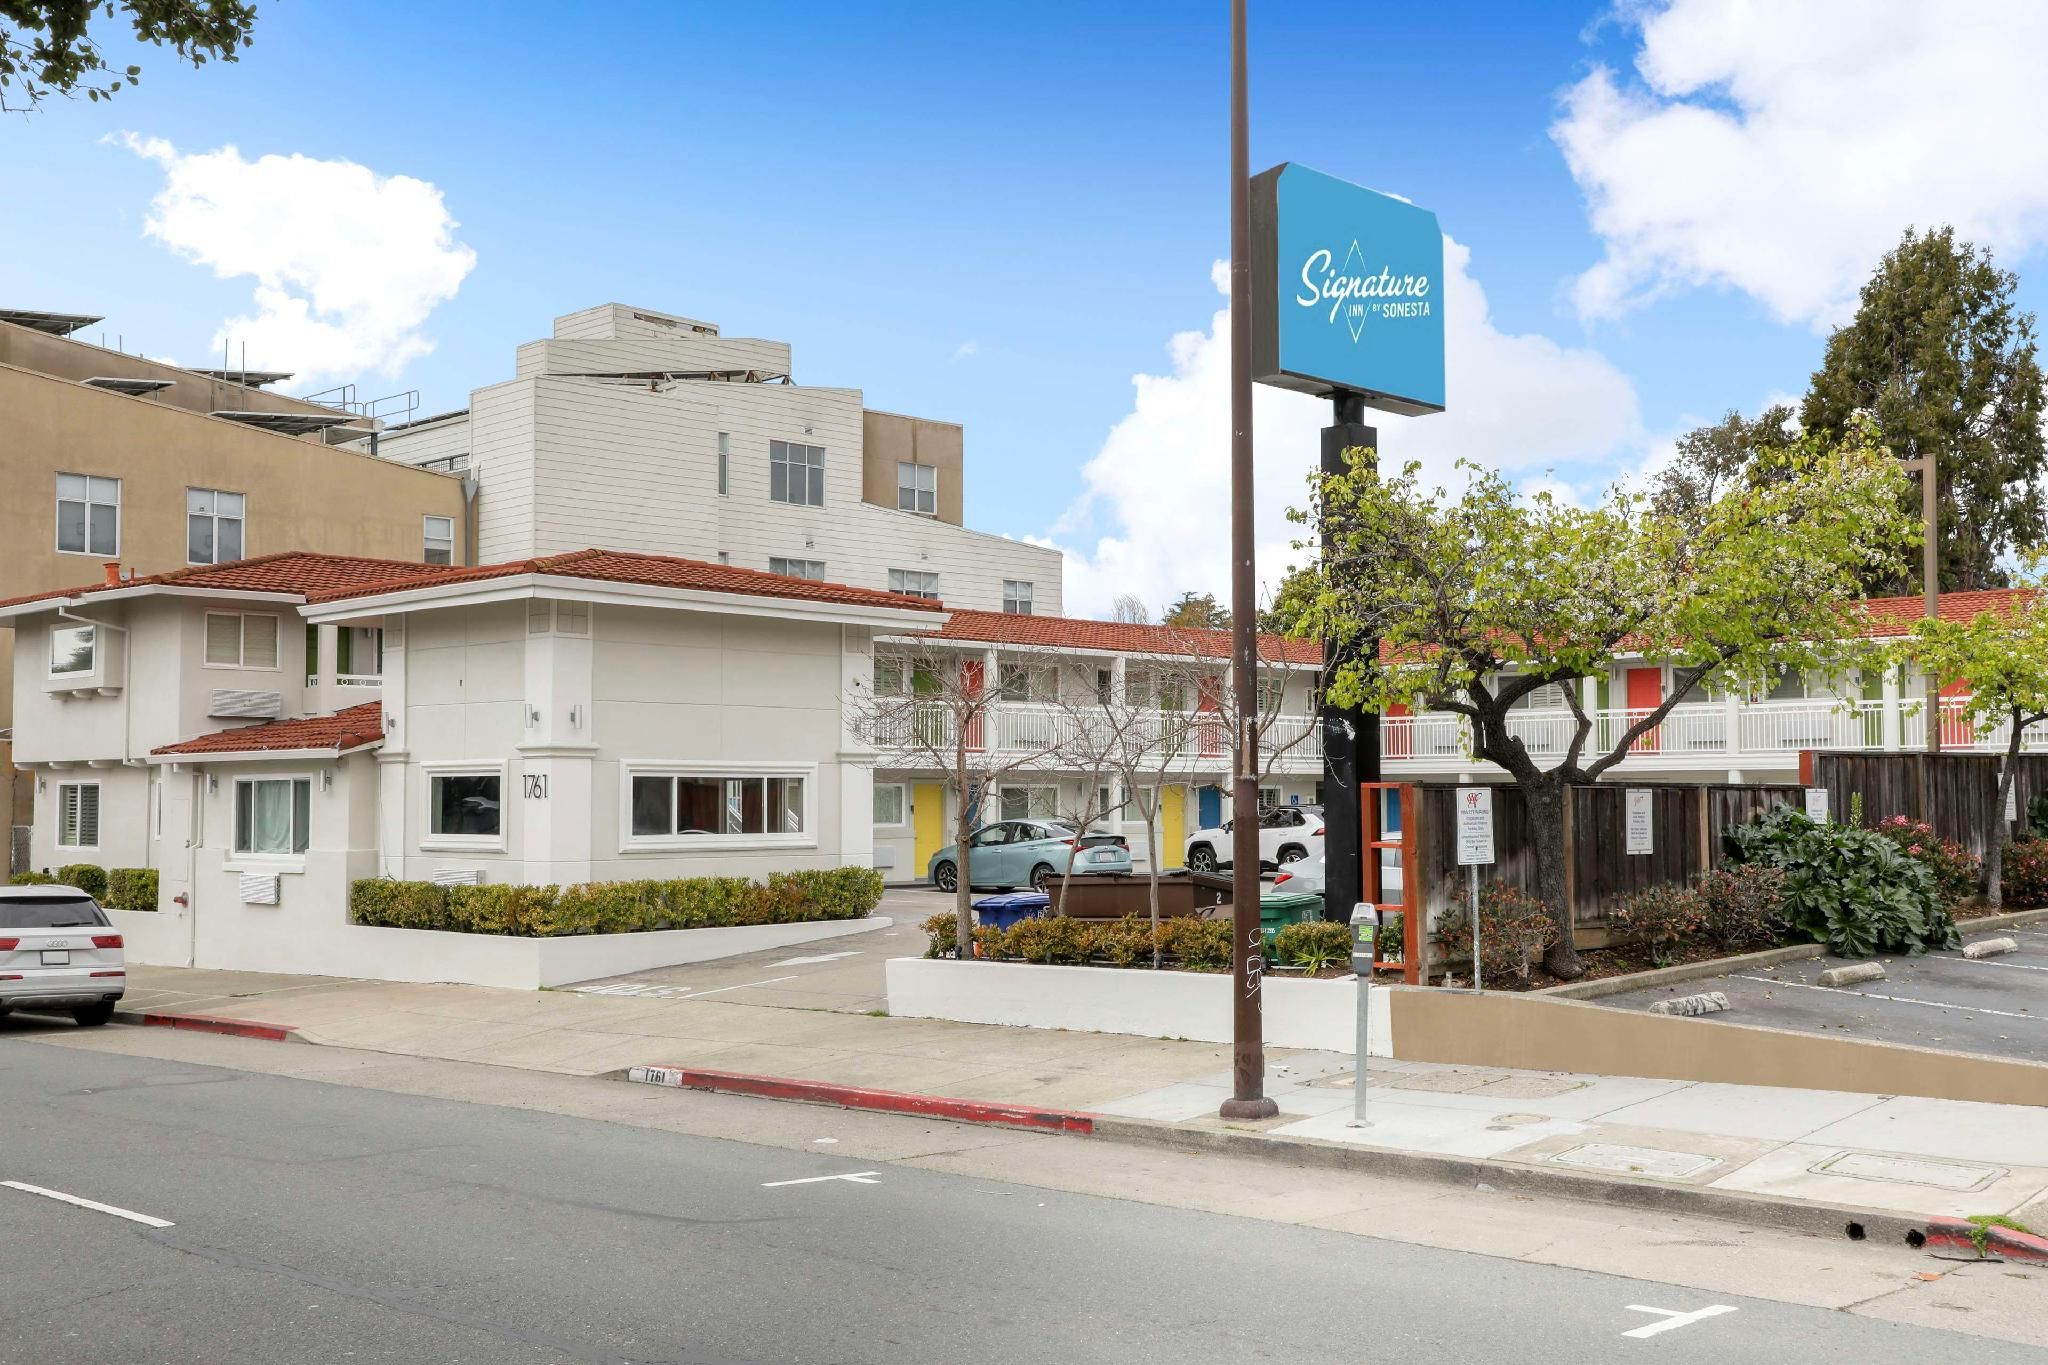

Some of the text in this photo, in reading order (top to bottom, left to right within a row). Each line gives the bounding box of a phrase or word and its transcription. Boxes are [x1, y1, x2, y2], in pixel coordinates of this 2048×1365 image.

[1297, 250, 1429, 324] Signature
[1349, 302, 1430, 318] INN BY SONESTA
[522, 774, 547, 799] 1761
[1216, 892, 1222, 904] 2
[645, 1069, 665, 1083] 1761
